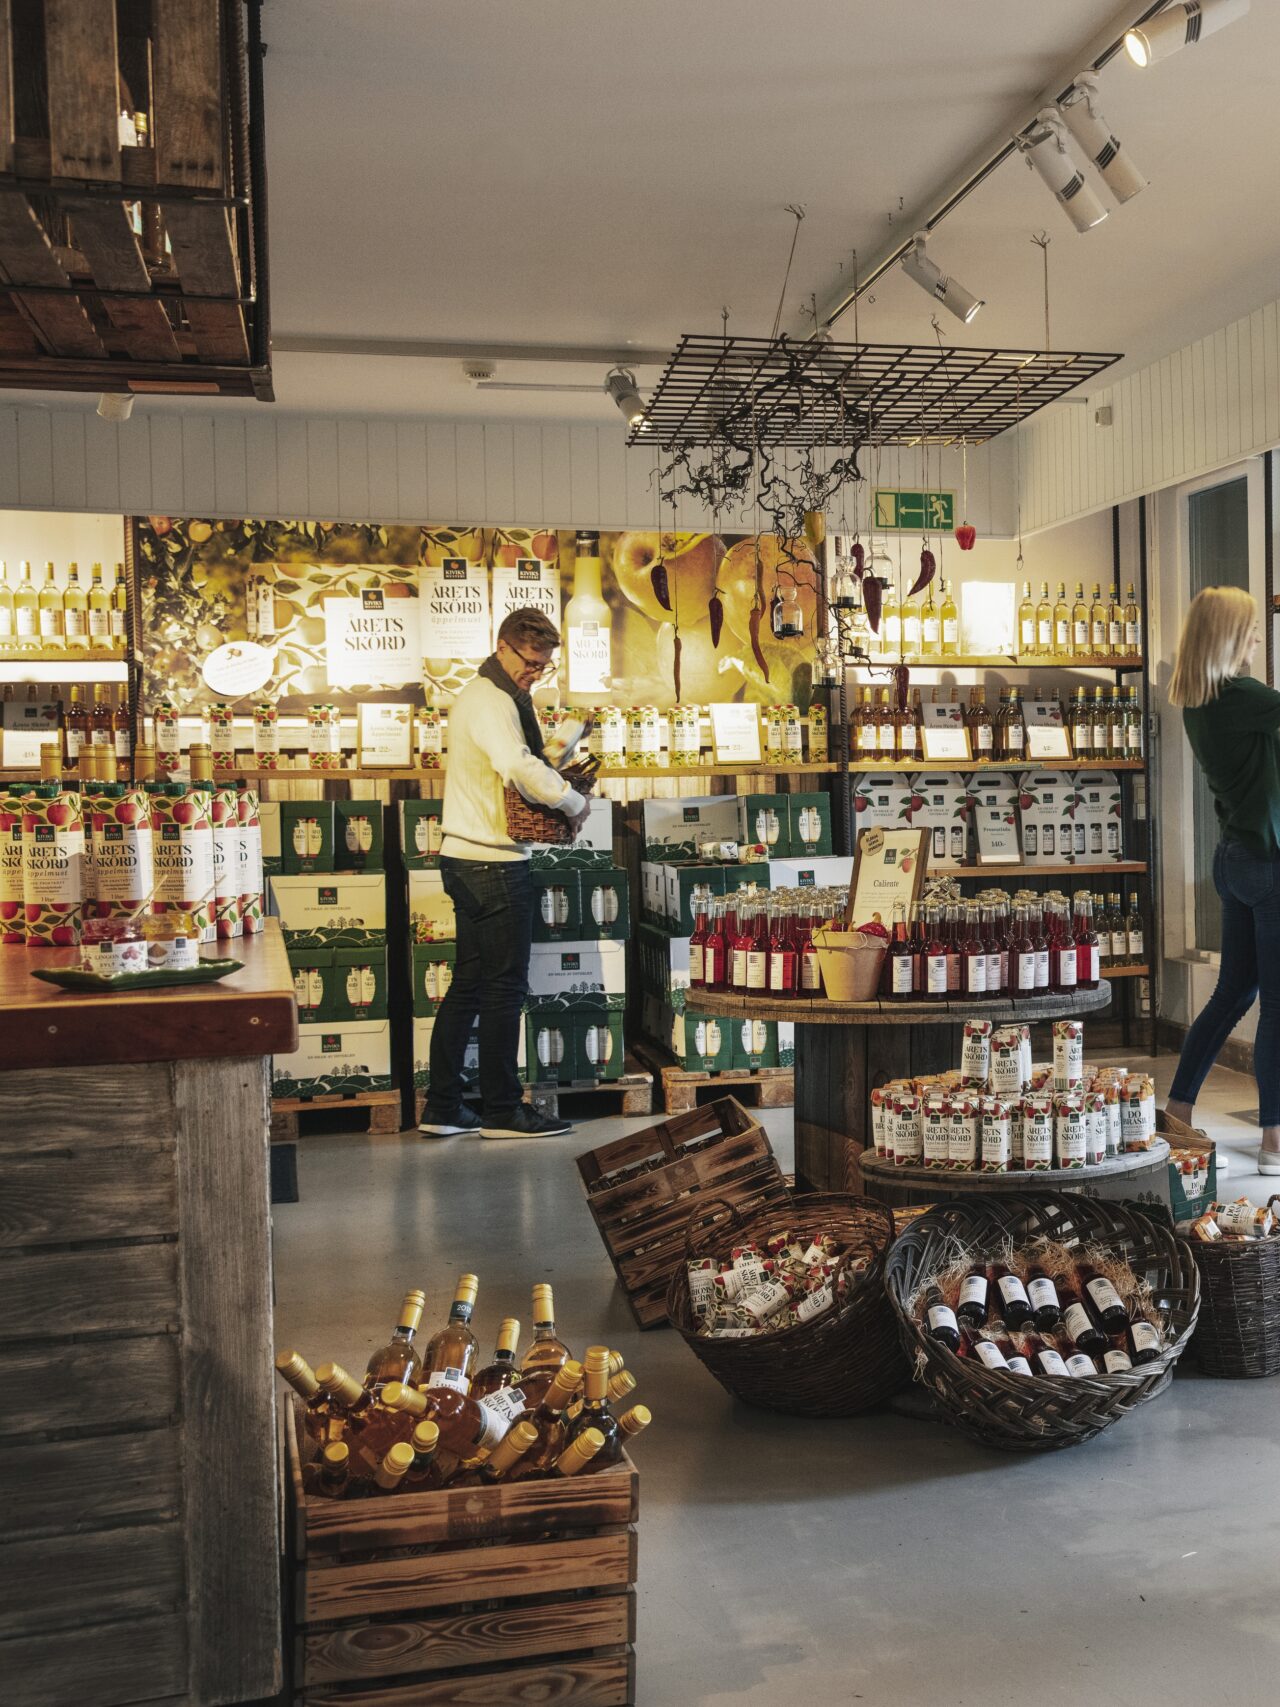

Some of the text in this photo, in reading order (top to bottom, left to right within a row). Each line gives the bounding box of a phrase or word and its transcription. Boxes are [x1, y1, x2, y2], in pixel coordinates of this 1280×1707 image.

[432, 582, 480, 598] ÅRETS
[506, 582, 554, 600] ÅRETS
[430, 598, 482, 614] SKÖRD
[346, 613, 404, 633] ÅRETS
[345, 632, 406, 650] SKÖRD
[2, 842, 22, 856] ÅRE
[28, 844, 68, 857] ÅRETS
[96, 841, 136, 856] ÅRETS
[154, 841, 192, 856] ÅRETS
[26, 857, 69, 870] SKÖRD
[96, 854, 138, 868] SKÖRD
[154, 854, 194, 868] SKÖRD
[2, 868, 24, 876] äppel
[874, 880, 900, 888] Caliente
[1128, 1110, 1142, 1118] DO
[896, 1121, 919, 1131] ÅRETS
[1028, 1125, 1052, 1134] ÅRETS
[895, 1130, 920, 1138] SKÖRD
[742, 1268, 751, 1287] SKÖ
[748, 1267, 758, 1286] ÅRE
